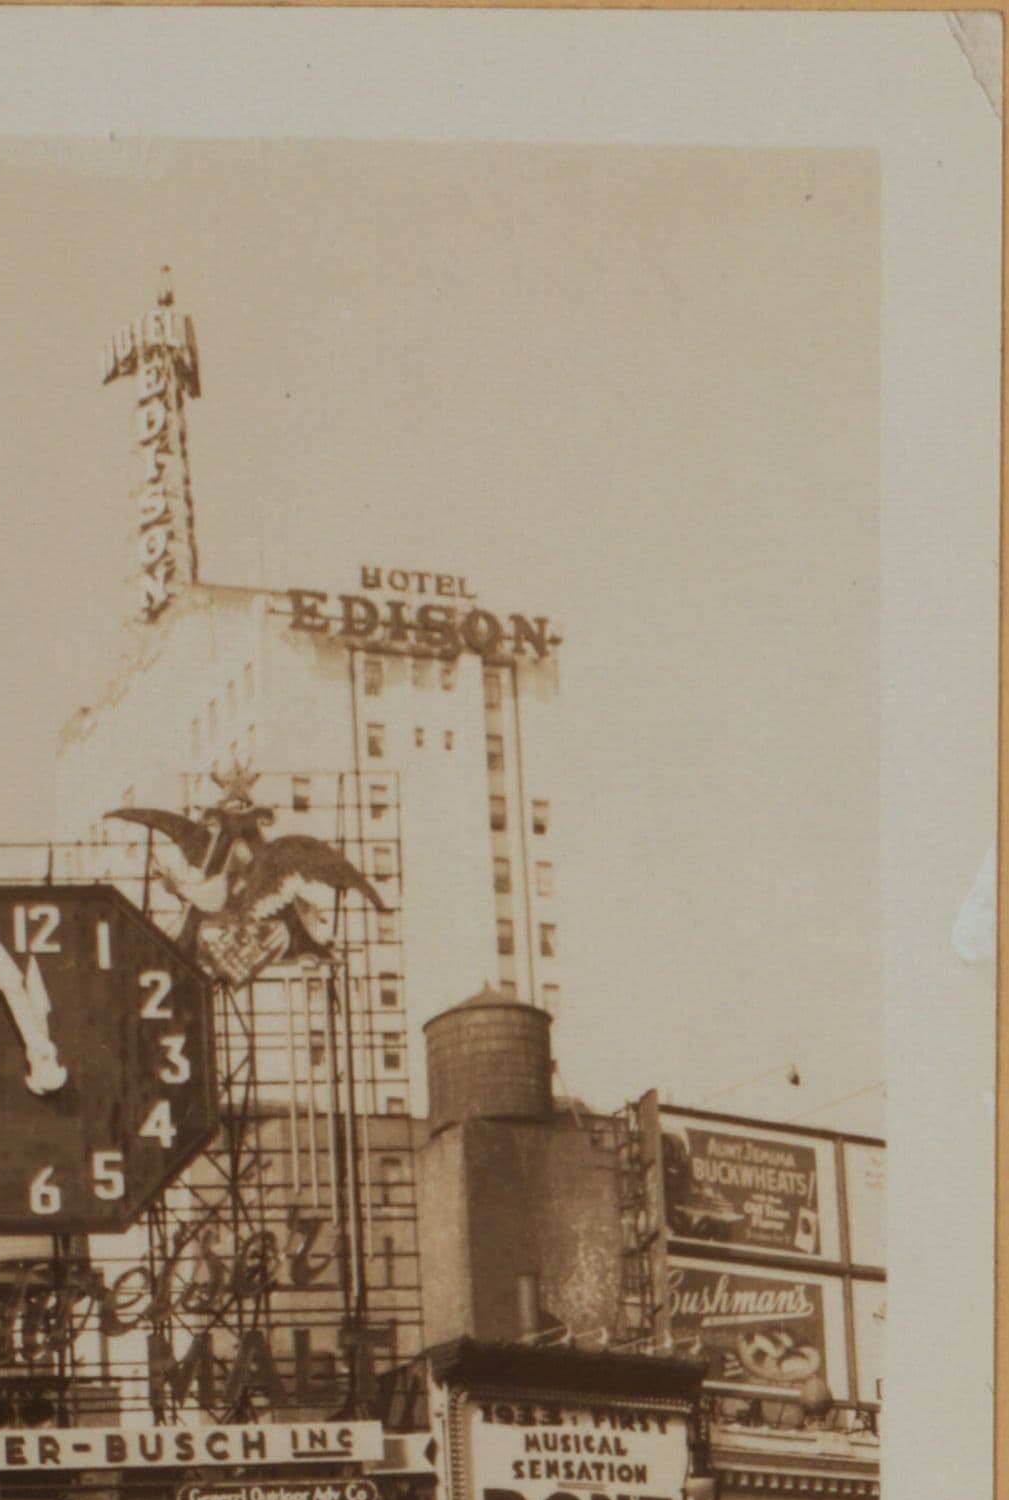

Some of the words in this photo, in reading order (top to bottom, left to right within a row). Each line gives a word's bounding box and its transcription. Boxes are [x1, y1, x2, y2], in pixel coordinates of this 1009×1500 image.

[361, 566, 476, 598] HOTEL
[290, 591, 550, 657] EDISON
[14, 905, 61, 953] 12
[97, 921, 111, 970] 1
[139, 971, 173, 1019] 2
[159, 1035, 191, 1085] 3
[139, 1101, 177, 1149] 4
[30, 1166, 61, 1215] 6
[93, 1152, 125, 1200] 5
[291, 1428, 353, 1450] INC
[525, 1432, 628, 1457] MUSICAL
[512, 1459, 647, 1484] SENSATION
